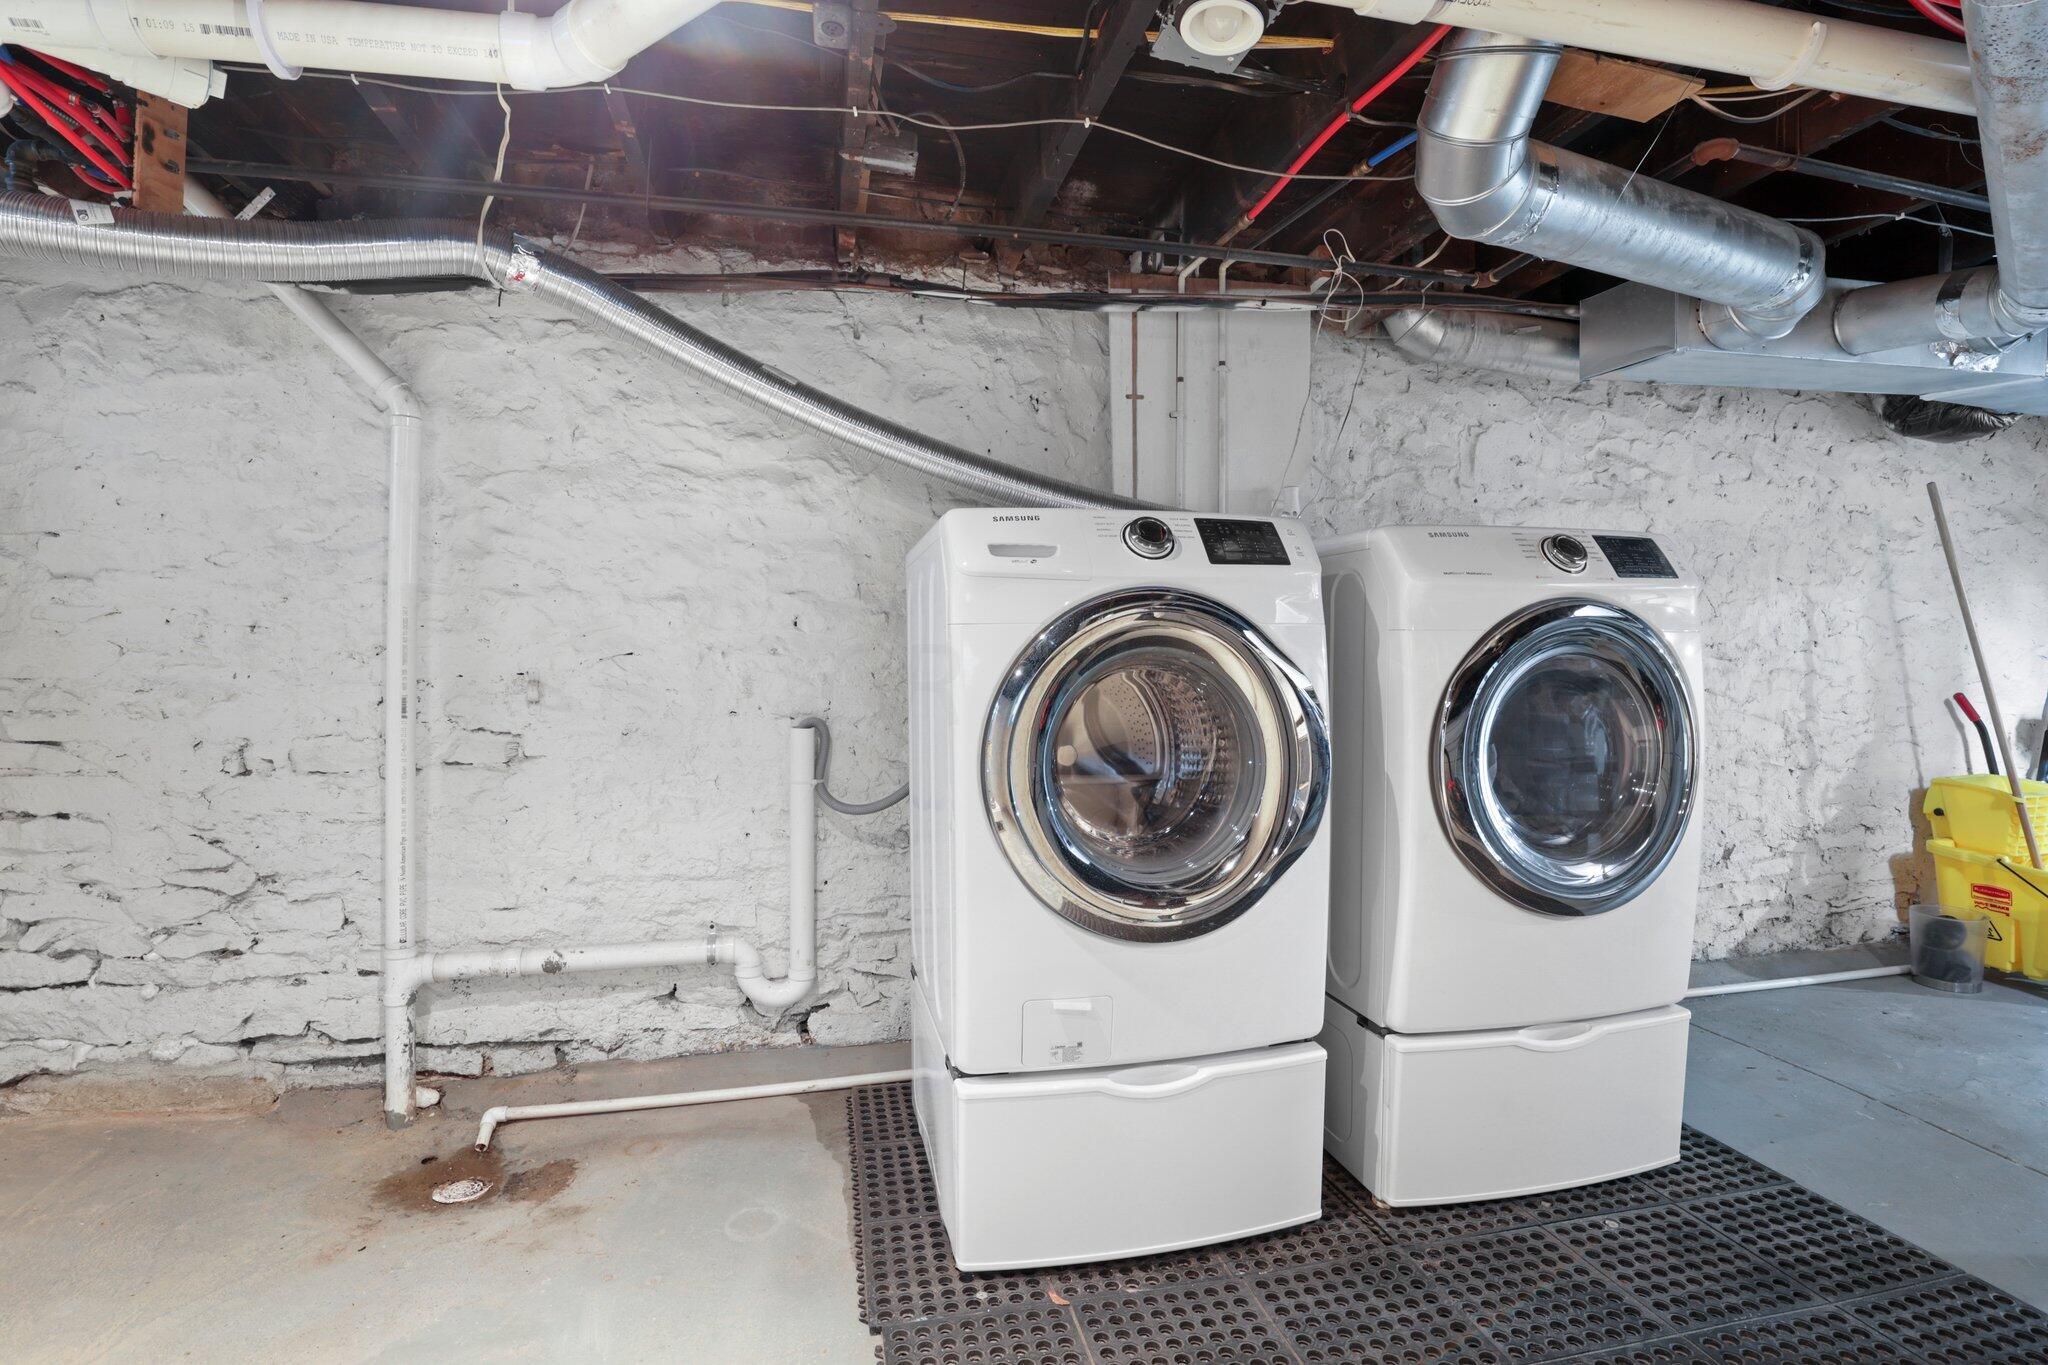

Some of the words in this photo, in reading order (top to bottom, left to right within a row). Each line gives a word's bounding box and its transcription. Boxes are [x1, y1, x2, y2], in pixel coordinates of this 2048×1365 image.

[276, 31, 301, 42] MADE
[305, 33, 317, 43] IN
[320, 34, 339, 46] USA
[346, 37, 407, 52] TEMPERATURE
[410, 42, 427, 53] NOT
[432, 44, 443, 55] TO
[447, 46, 479, 57] EXCEED
